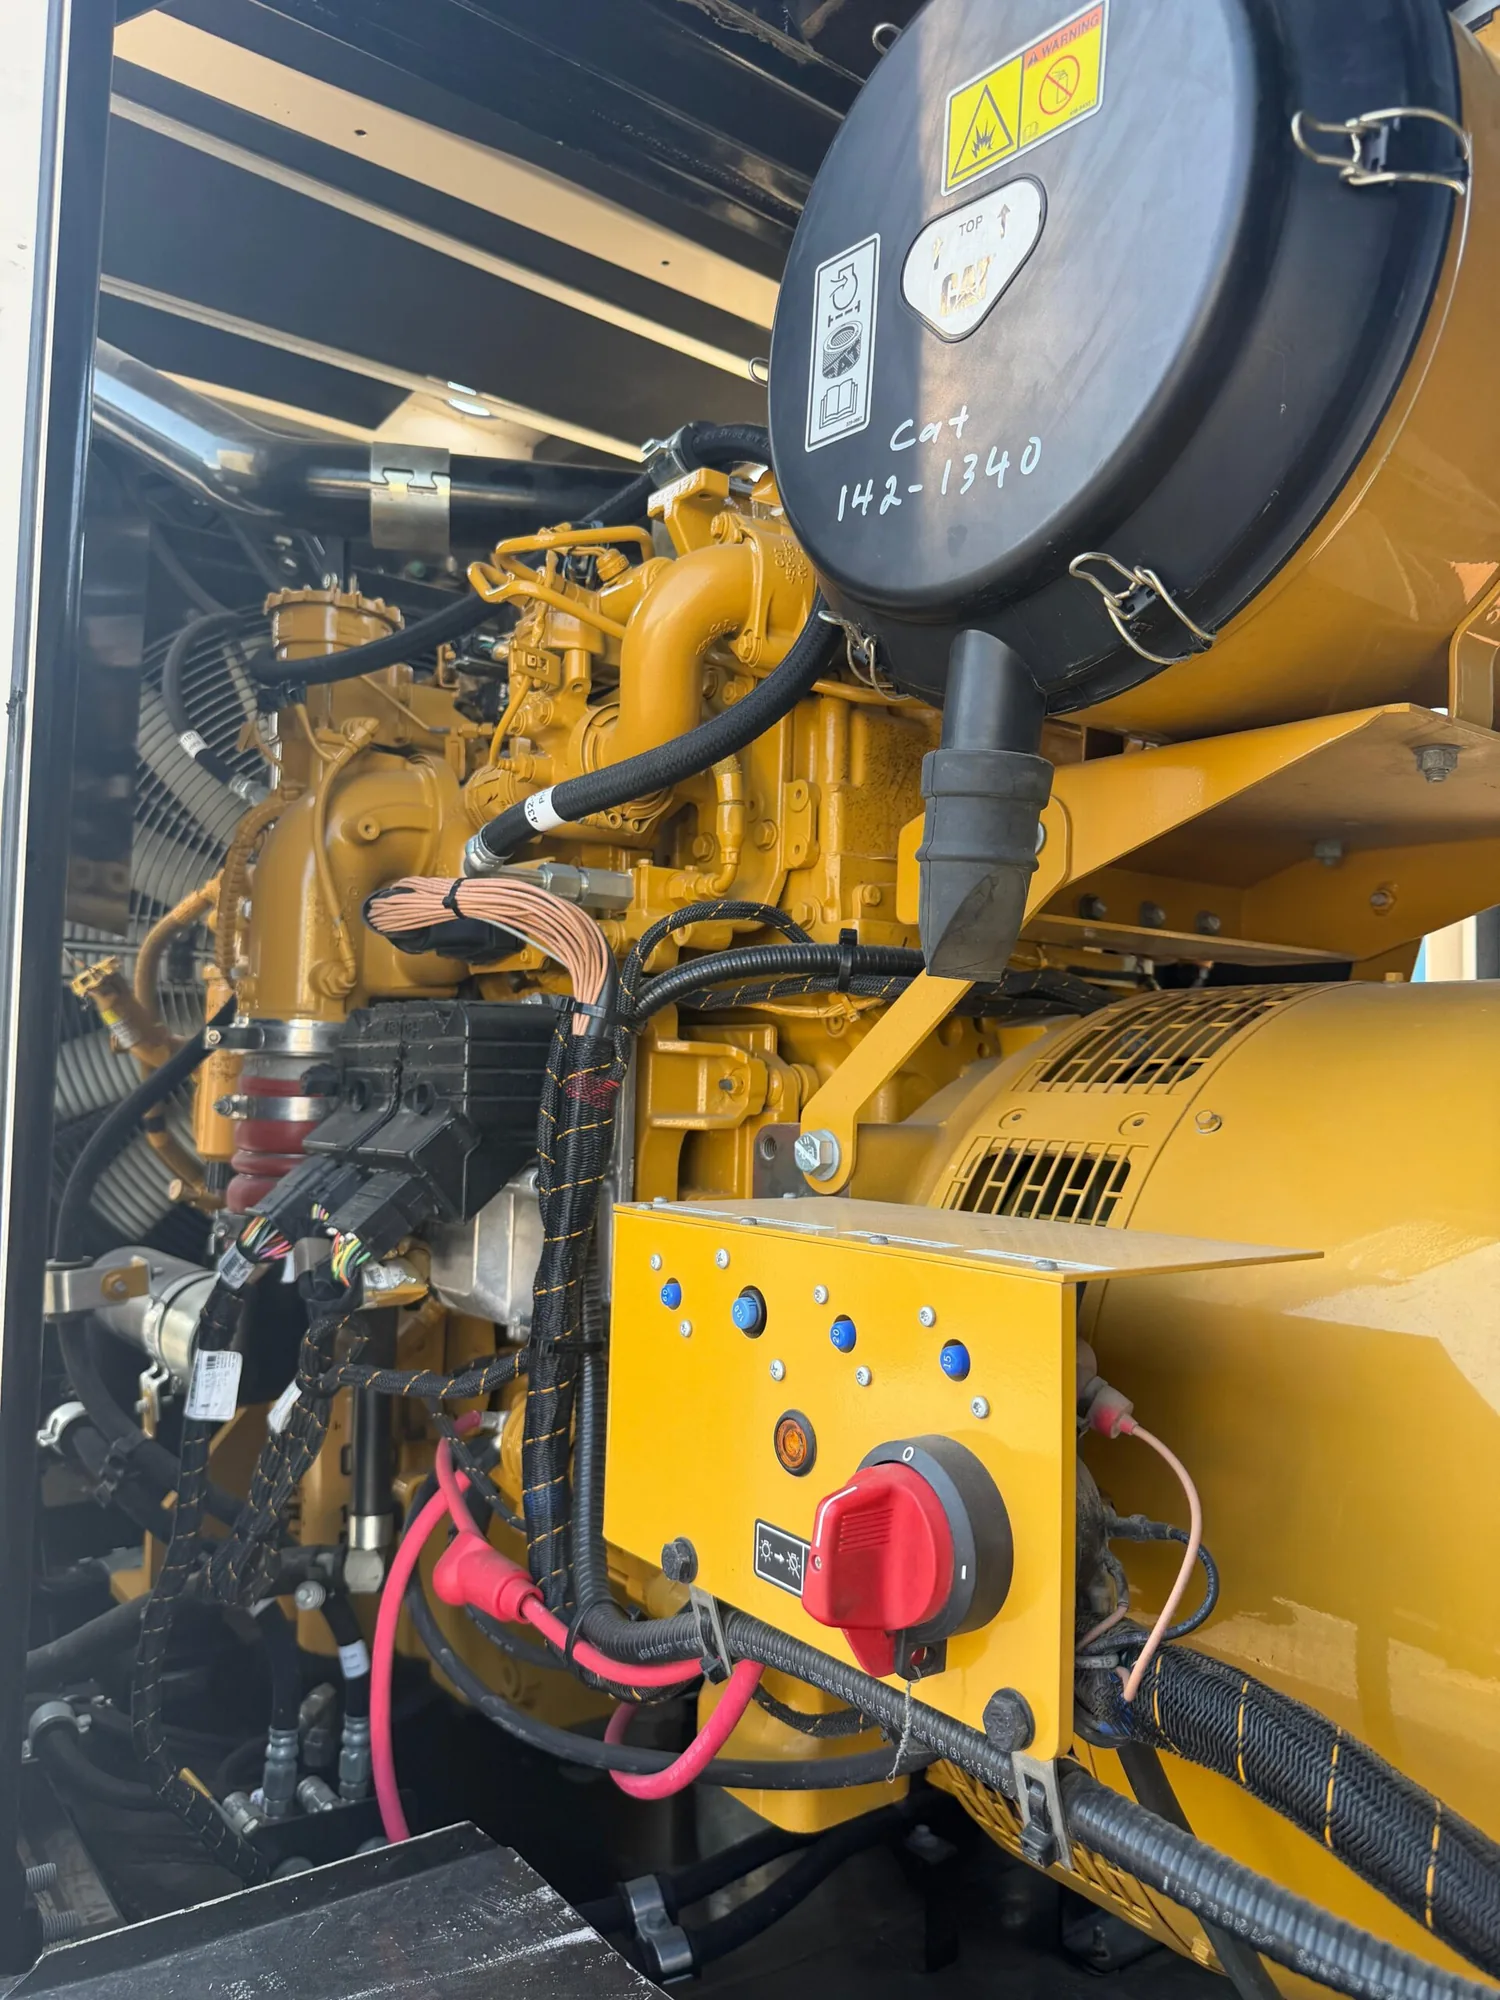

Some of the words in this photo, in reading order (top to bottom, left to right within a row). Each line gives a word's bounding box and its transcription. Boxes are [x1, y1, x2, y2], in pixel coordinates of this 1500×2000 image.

[1042, 14, 1099, 57] WARNING
[958, 215, 983, 236] TOP
[940, 255, 993, 317] CAT
[837, 436, 1042, 522] 142-1340
[733, 1304, 744, 1322] 120
[832, 1328, 840, 1344] 20
[943, 1355, 952, 1369] 15
